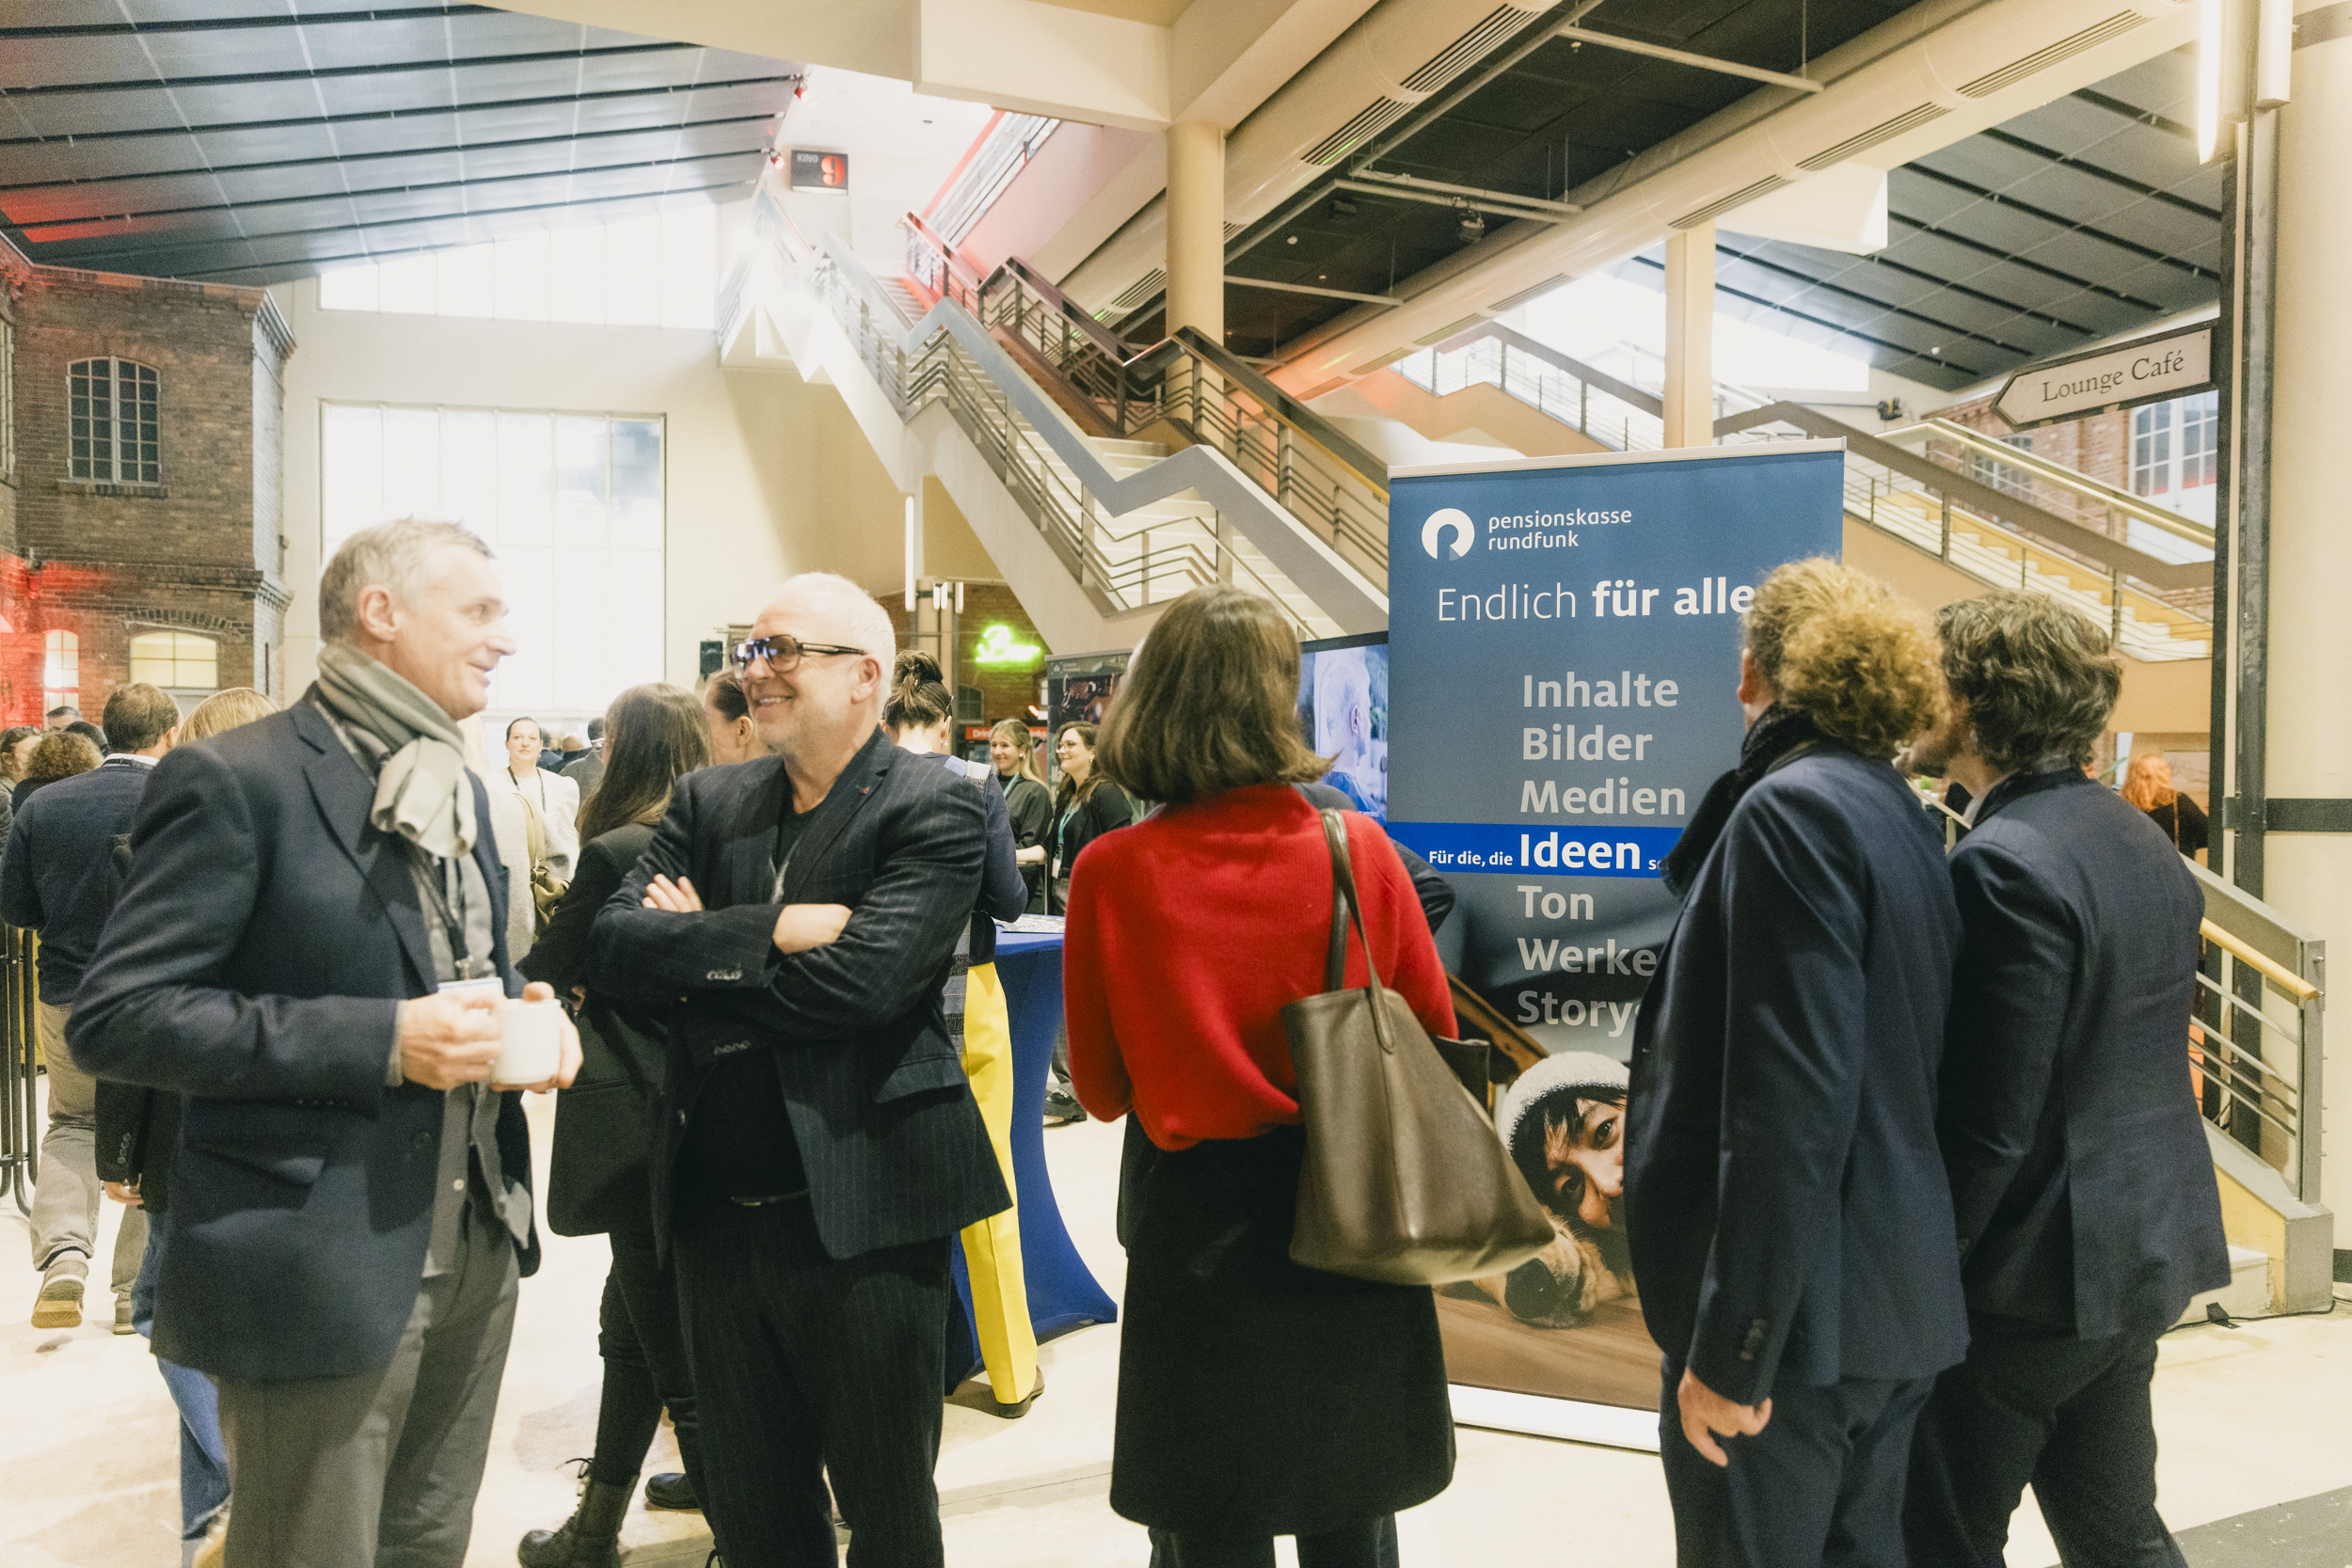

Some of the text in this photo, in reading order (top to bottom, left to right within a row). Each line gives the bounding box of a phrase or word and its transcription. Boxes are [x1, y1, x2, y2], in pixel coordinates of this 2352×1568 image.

[797, 153, 818, 164] KINO
[821, 155, 845, 187] 9
[2042, 350, 2184, 403] Lounge Café
[1488, 508, 1632, 533] pensionskasse
[1488, 530, 1579, 550] rundfunk
[1438, 577, 1755, 622] Endlich für alle
[1523, 671, 1679, 707] Inhalte
[1523, 723, 1653, 761] Bilder
[1520, 777, 1686, 816] Medien
[1429, 849, 1454, 864] Für
[1457, 849, 1486, 867] die,
[1489, 850, 1514, 865] die
[1520, 832, 1641, 870] Ideen
[1517, 885, 1594, 920] Ton
[1517, 938, 1657, 976] Werke
[1517, 990, 1641, 1037] Story
